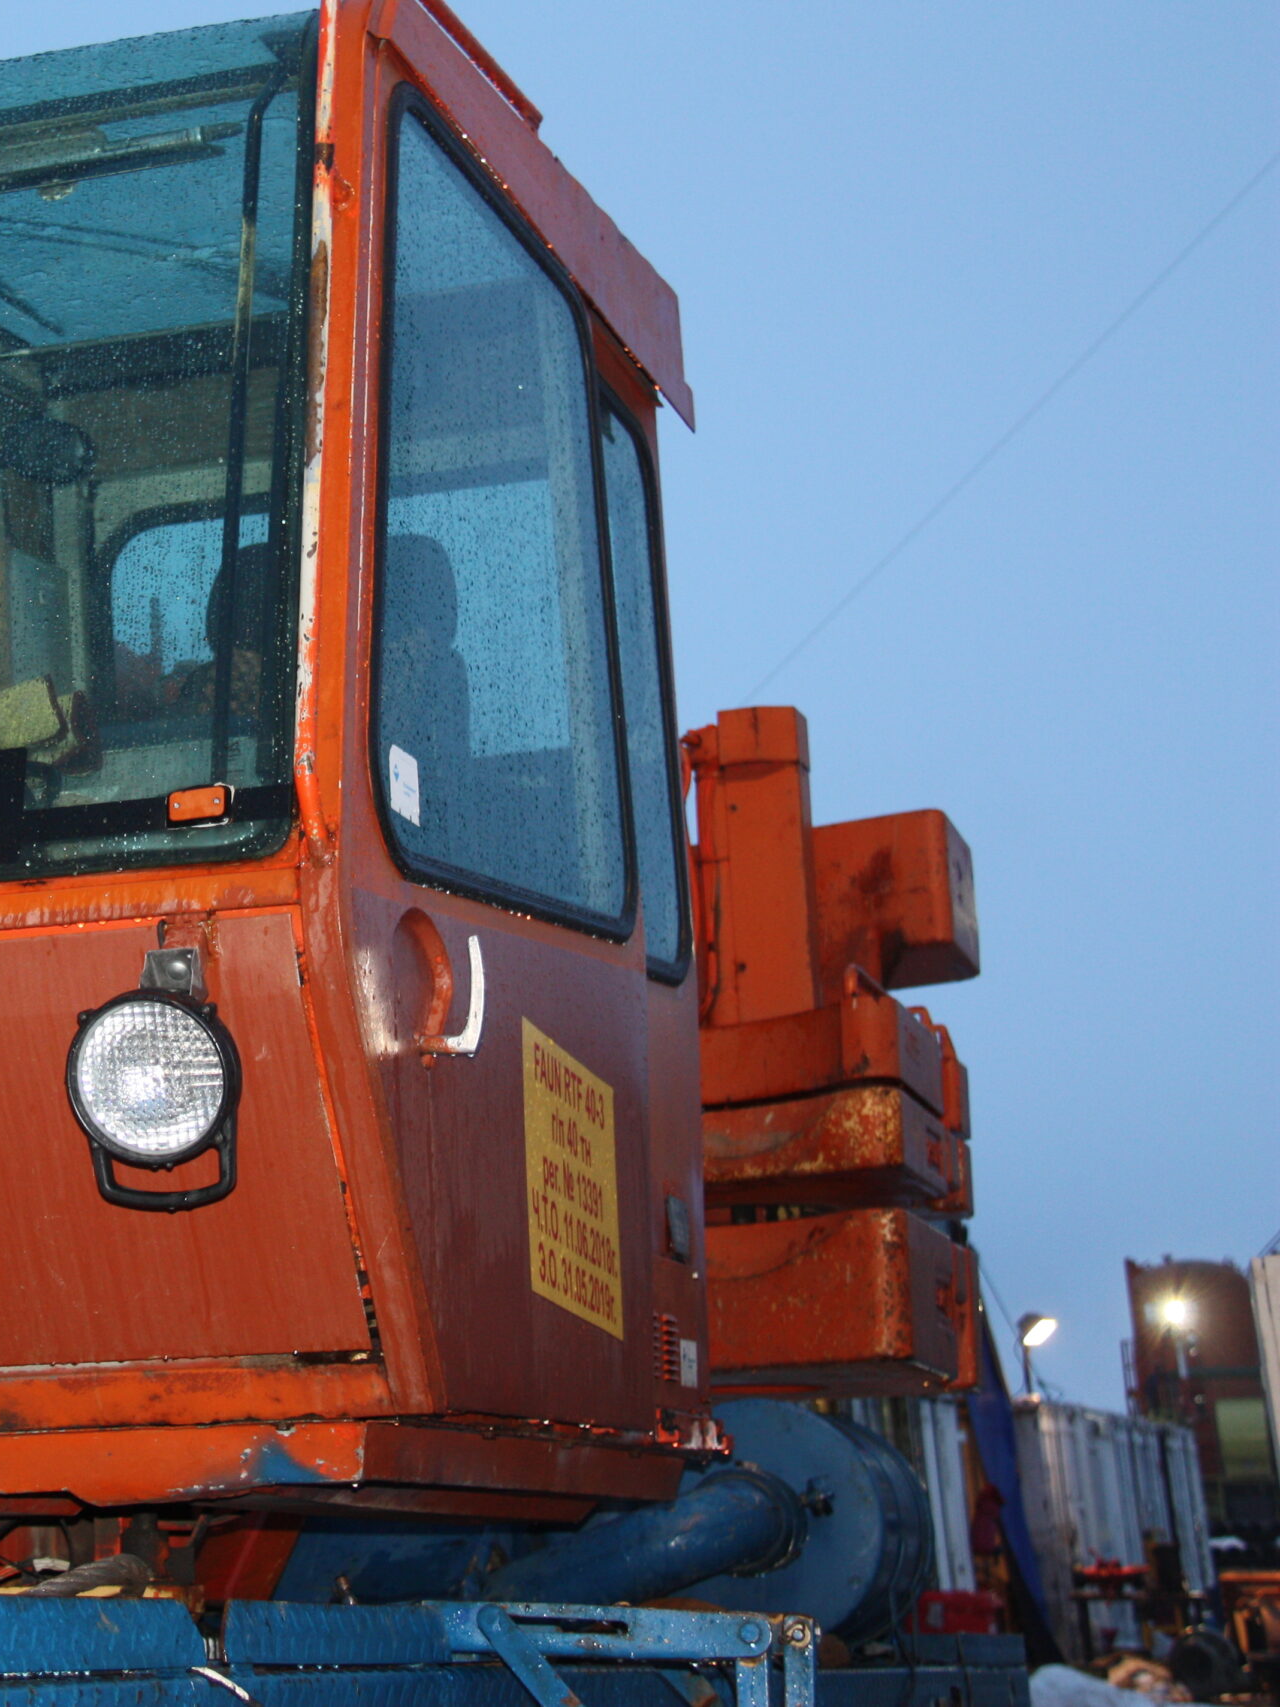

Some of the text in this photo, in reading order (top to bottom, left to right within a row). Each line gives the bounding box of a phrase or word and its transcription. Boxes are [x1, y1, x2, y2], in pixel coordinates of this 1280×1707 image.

[534, 1042, 605, 1130] FAUN RTF 40-3
[567, 1117, 578, 1158] 40
[543, 1155, 561, 1195] рег.
[577, 1171, 603, 1223] 13391
